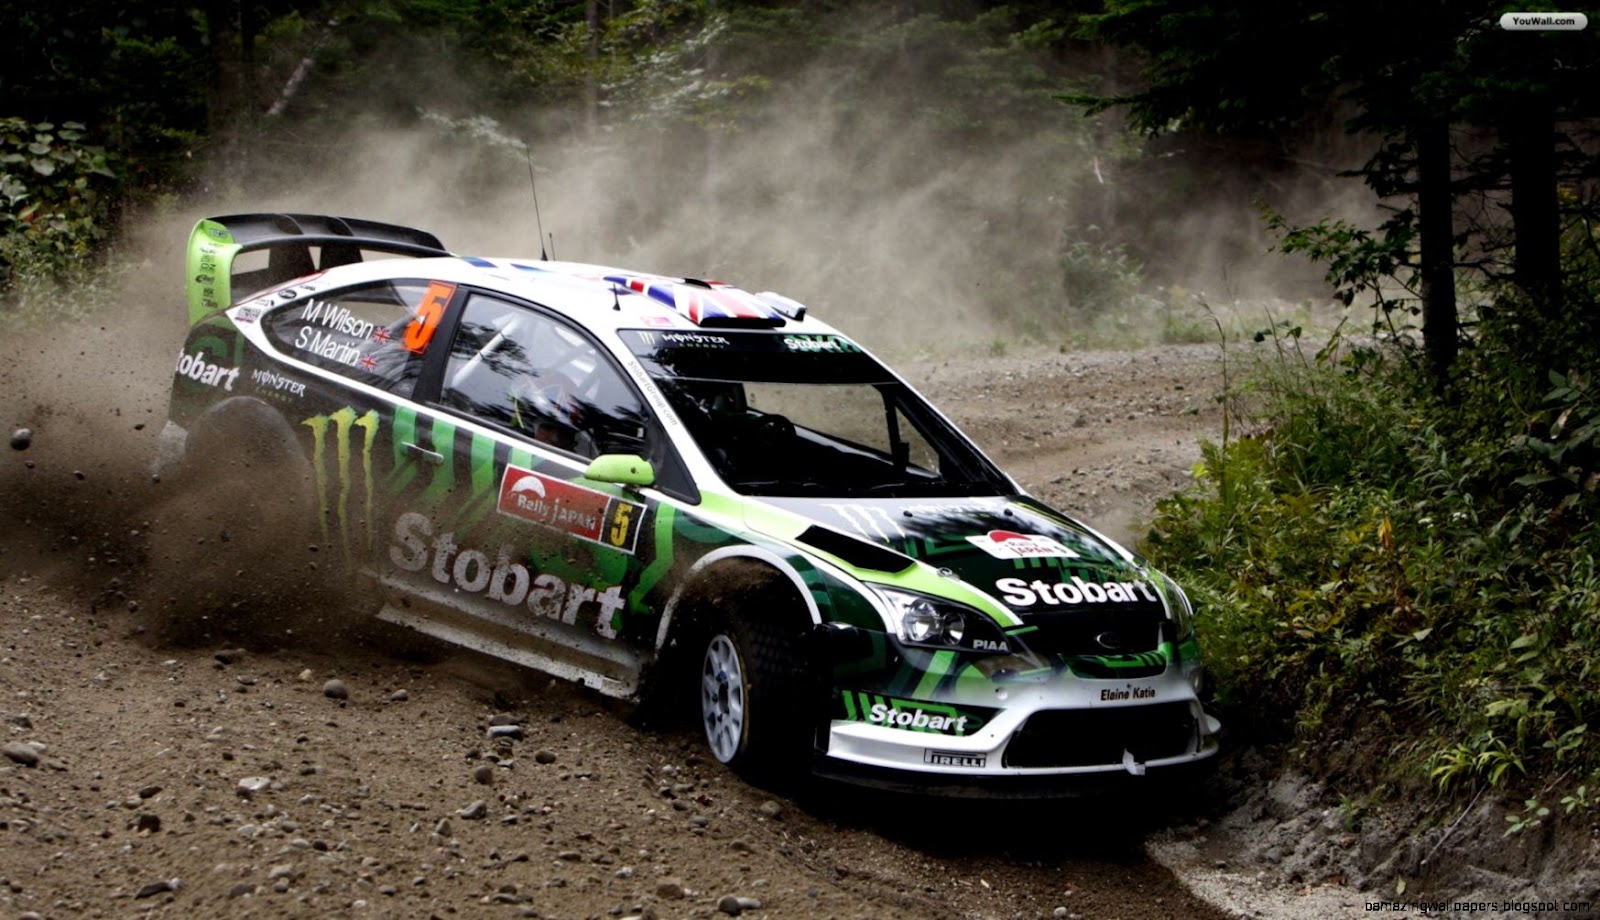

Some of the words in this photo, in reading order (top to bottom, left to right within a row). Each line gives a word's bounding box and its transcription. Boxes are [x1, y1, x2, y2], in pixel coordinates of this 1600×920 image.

[301, 298, 324, 323] M
[322, 303, 374, 340] Wilson
[403, 281, 455, 351] 5
[295, 325, 312, 349] S
[310, 331, 362, 367] Martin
[517, 494, 550, 517] Rally
[610, 502, 634, 547] 5
[389, 512, 626, 640] Stobart
[995, 576, 1157, 607] Stobart
[972, 639, 1010, 652] PIAA
[1100, 688, 1130, 701] Elaine
[1133, 686, 1156, 699] Katie
[869, 703, 968, 732] Stobart
[925, 748, 987, 768] PIRELLI
